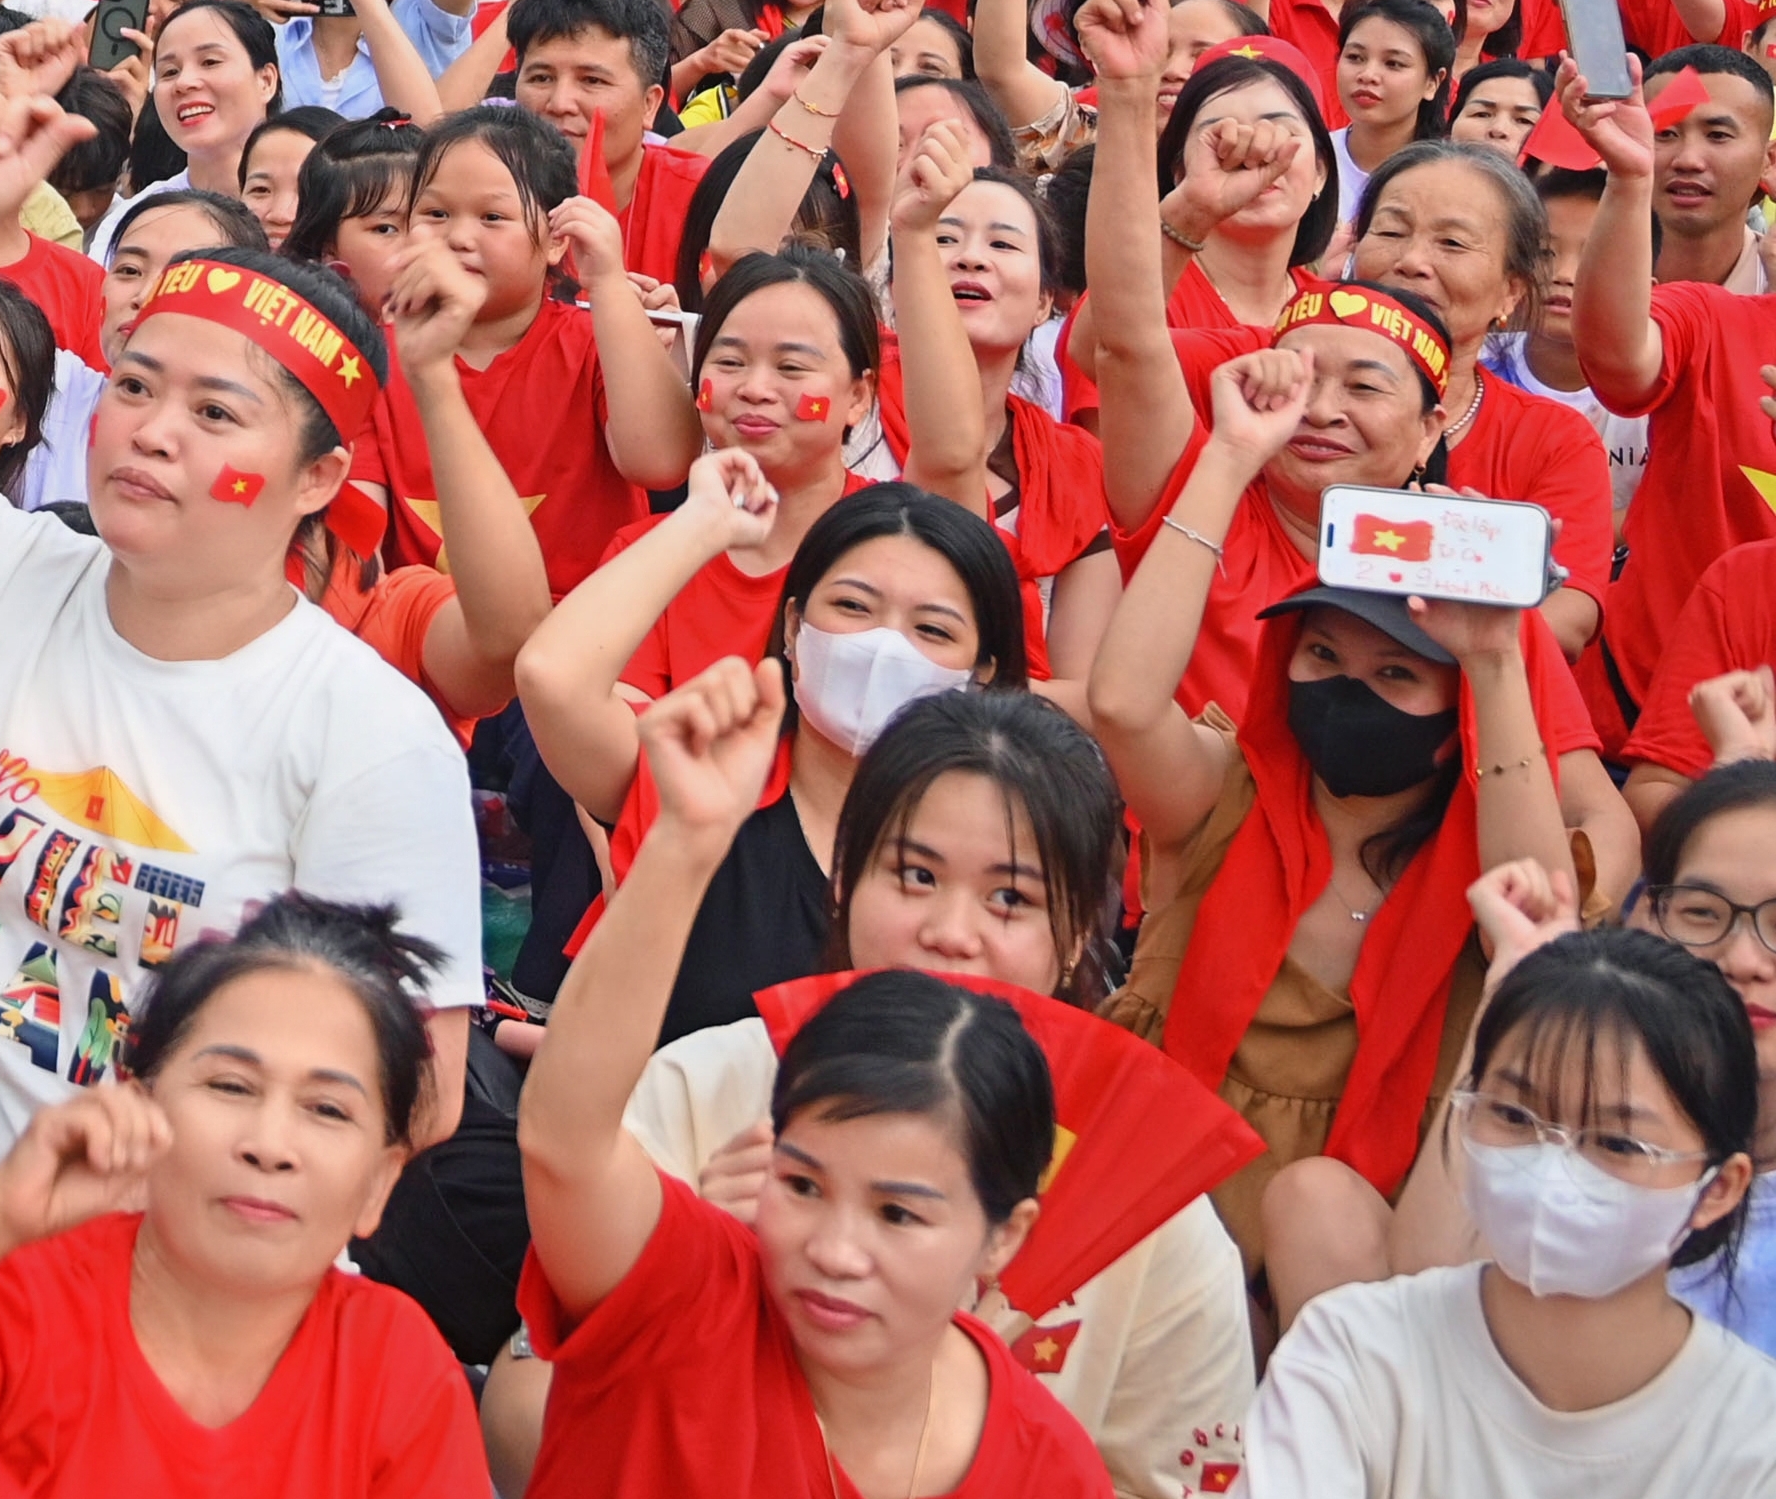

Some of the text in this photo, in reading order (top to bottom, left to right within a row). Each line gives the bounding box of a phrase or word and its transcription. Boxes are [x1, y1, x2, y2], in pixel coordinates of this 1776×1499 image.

[242, 276, 299, 328] VIỆT
[288, 305, 345, 367] NAM
[1291, 290, 1324, 324] YÊU
[1370, 301, 1412, 341] VIỆT
[1412, 328, 1446, 377] NAM
